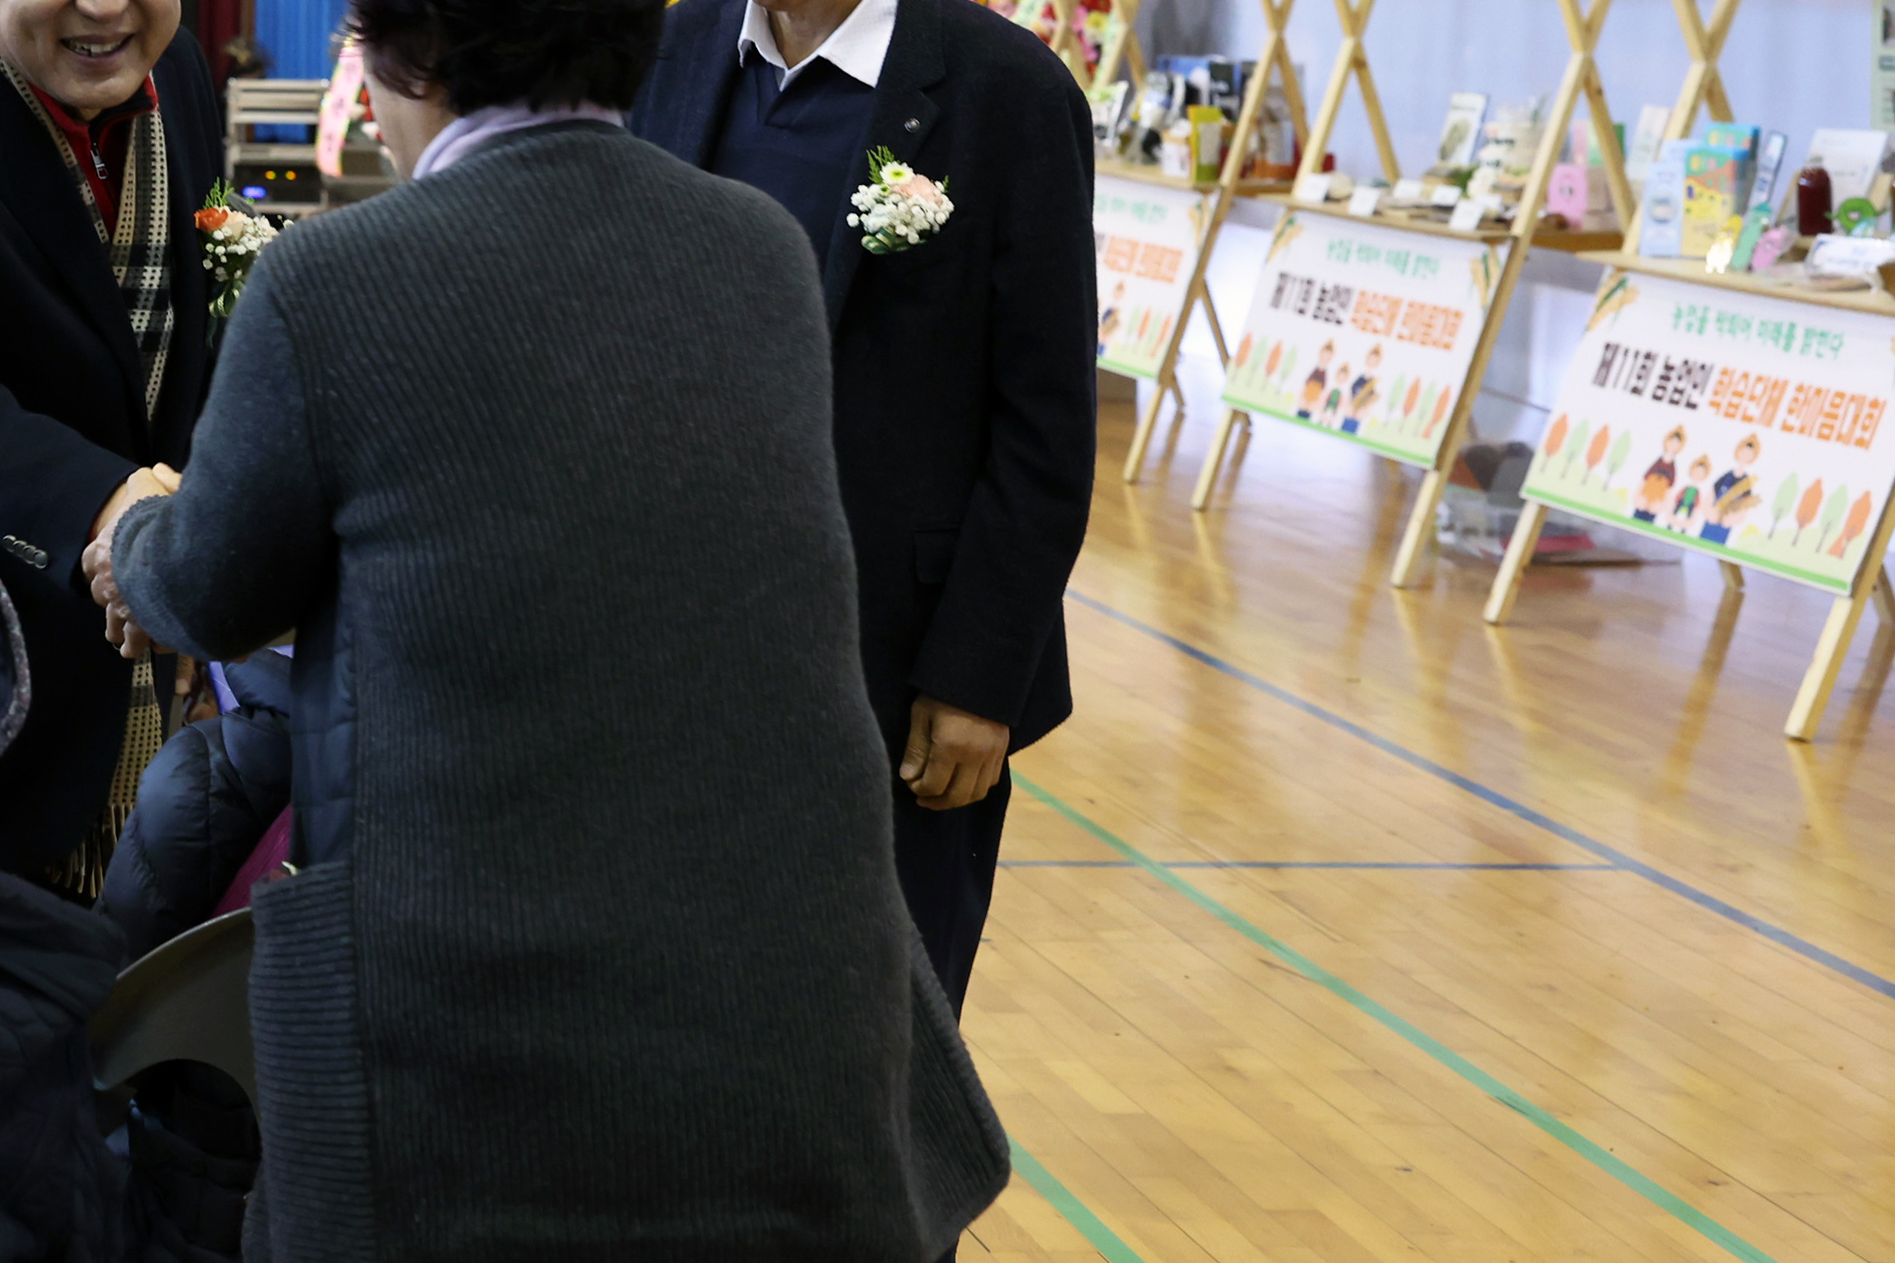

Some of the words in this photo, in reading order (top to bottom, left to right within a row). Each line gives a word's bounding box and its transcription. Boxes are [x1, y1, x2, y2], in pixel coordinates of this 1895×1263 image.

[1592, 342, 1659, 398] 제11회
[1651, 354, 1714, 410] 농업인
[1708, 366, 1790, 428] 학습단체
[1780, 383, 1888, 451] 한마음대회
